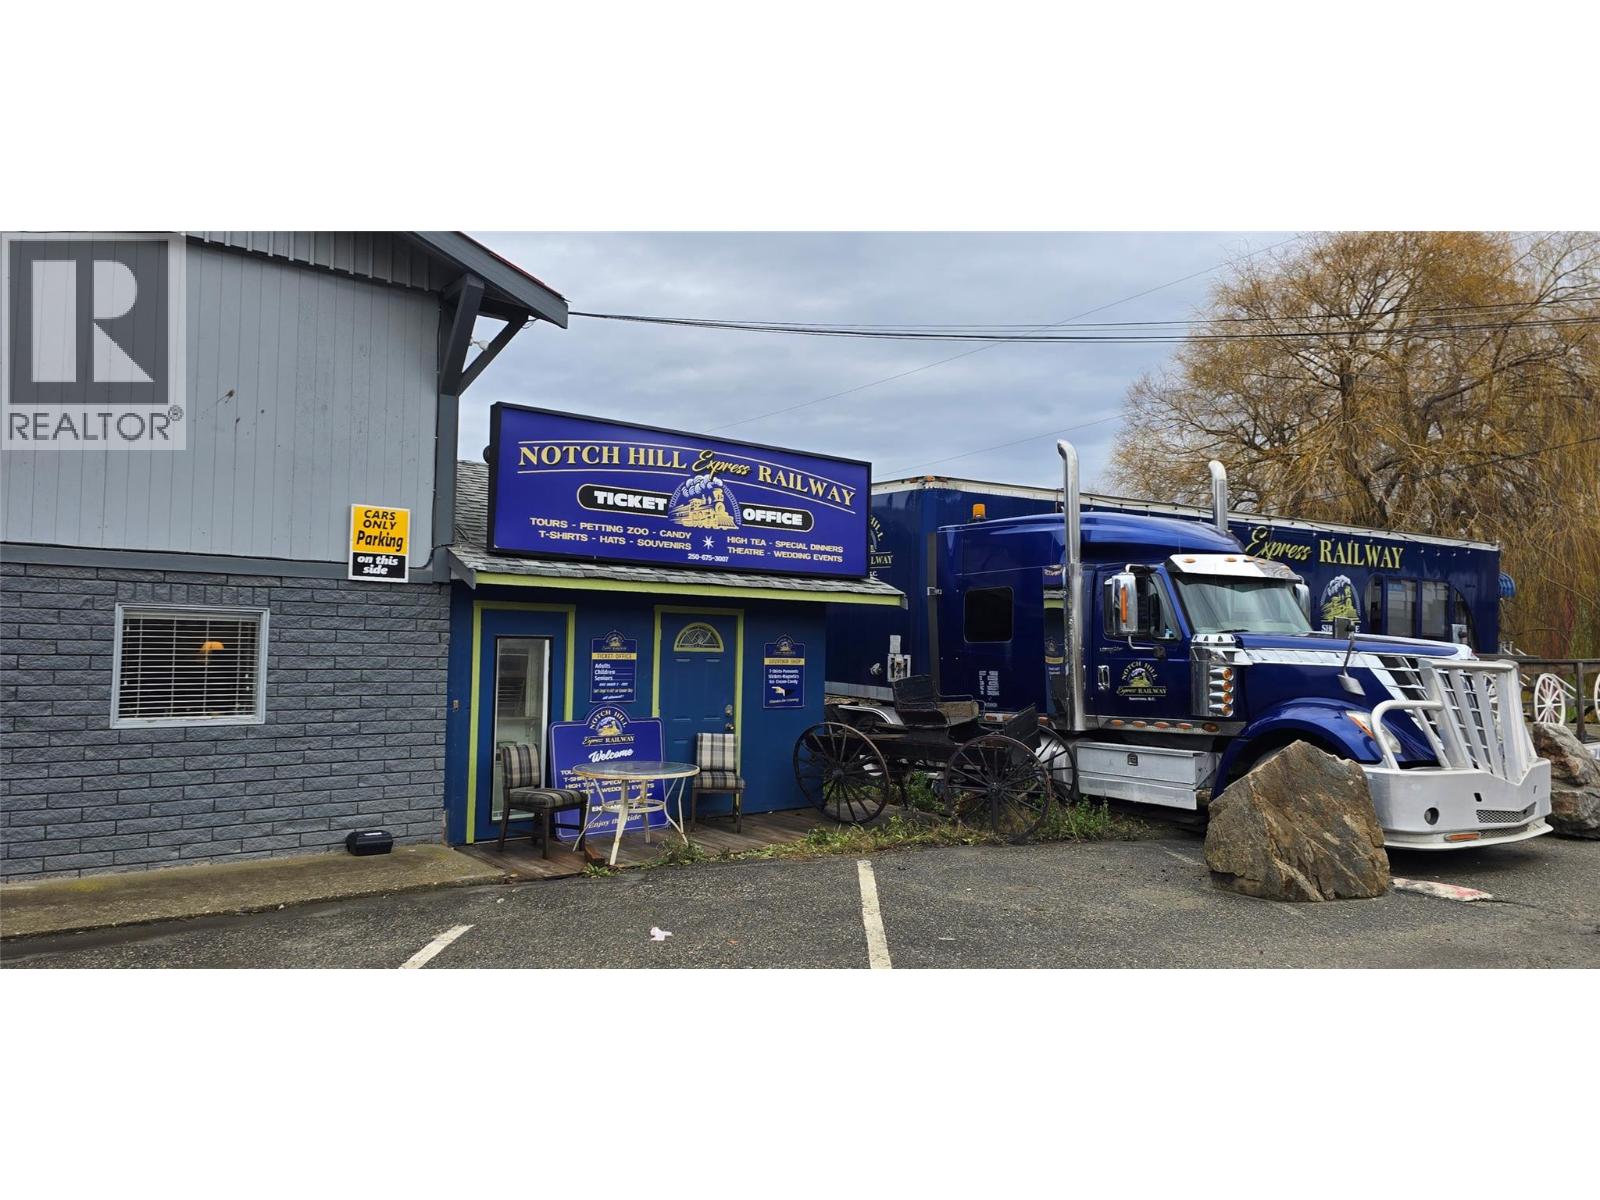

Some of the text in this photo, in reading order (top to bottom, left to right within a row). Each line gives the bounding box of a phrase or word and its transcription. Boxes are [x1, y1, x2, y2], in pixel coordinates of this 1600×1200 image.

[518, 445, 855, 506] NOTCH HILL Express RAILWAY
[364, 509, 396, 520] CARS
[594, 490, 803, 526] TICKET OFFICE
[363, 519, 397, 530] ONLY
[529, 517, 568, 529] TOURS
[580, 522, 624, 533] PETTING
[627, 527, 649, 536] ZOO
[659, 530, 692, 539] CANDY
[356, 529, 404, 552] Parking
[538, 530, 588, 542] T-SHIRTS
[600, 536, 626, 545] HATS
[637, 538, 692, 550] SOUVENIRS
[727, 536, 748, 545] HIGH
[750, 538, 766, 546] TEA
[775, 540, 808, 550] SPECIAL
[810, 544, 844, 553] DINNERS
[1244, 525, 1403, 569] Express RAILWAY
[357, 555, 398, 566] on this
[687, 553, 729, 563] 250-675-3007
[727, 546, 765, 556] THEATRE
[773, 551, 811, 560] WEDDING
[813, 554, 843, 563] EVENTS
[870, 555, 893, 565] LWAY
[362, 564, 388, 575] side
[589, 709, 628, 729] NOTCH HILL
[588, 748, 634, 762] Welcome
